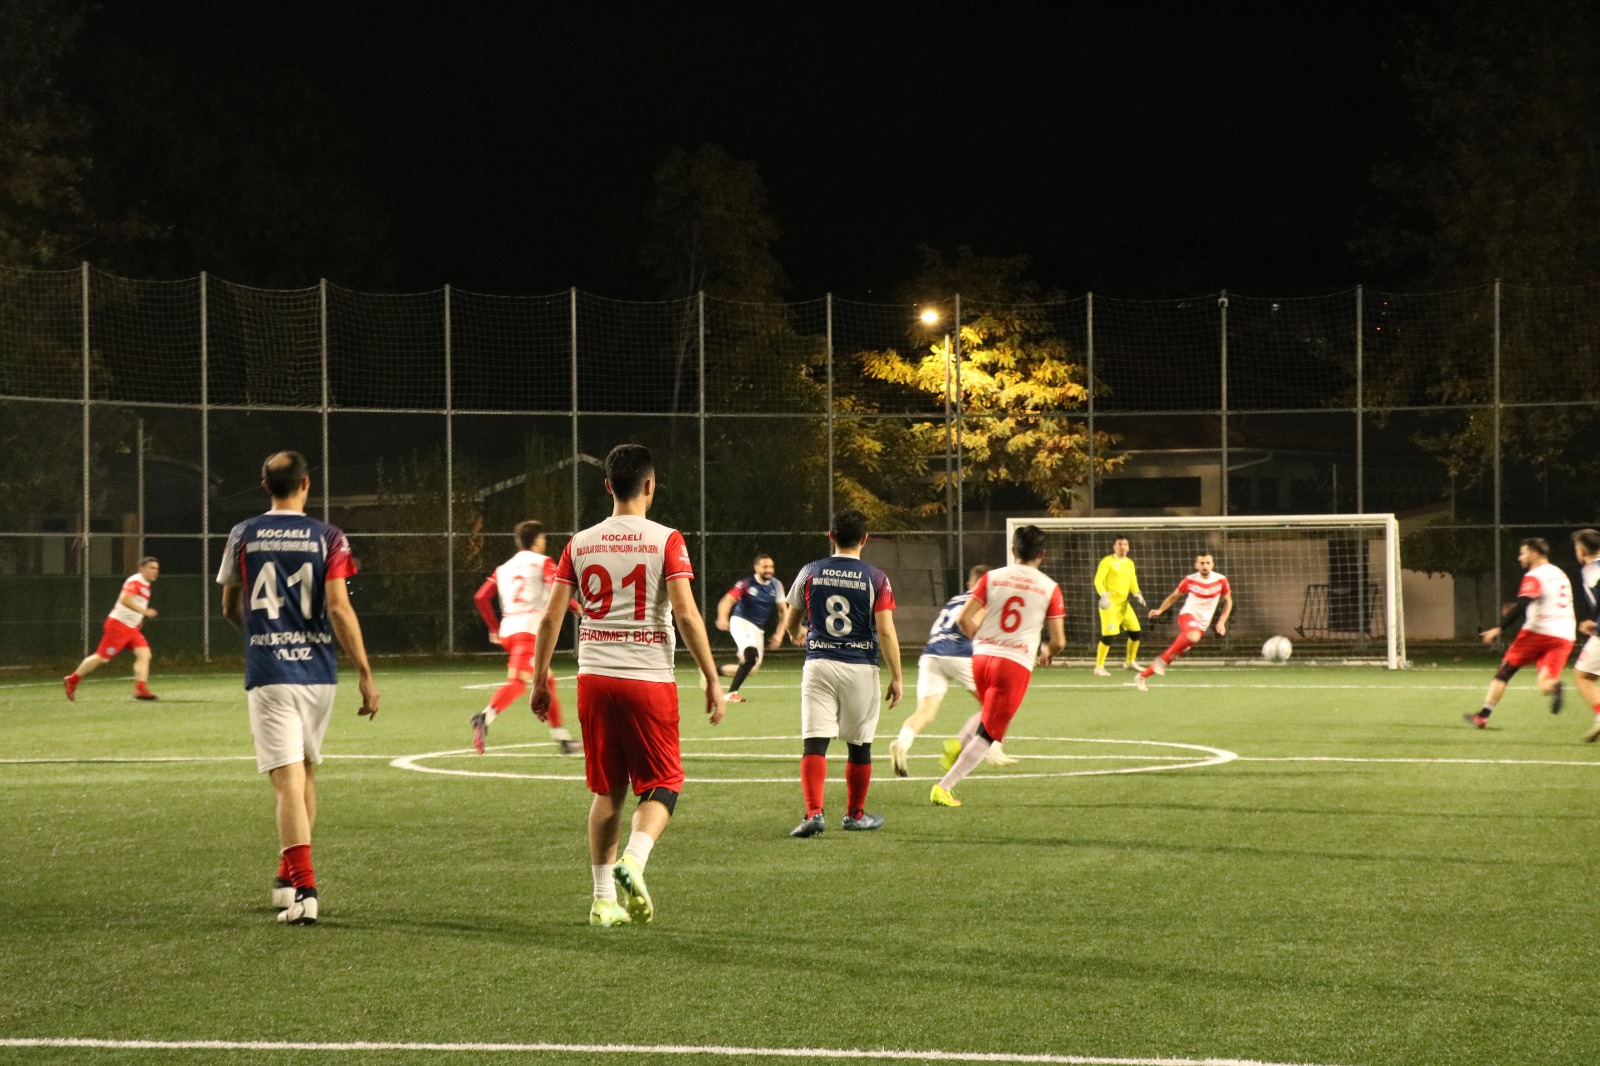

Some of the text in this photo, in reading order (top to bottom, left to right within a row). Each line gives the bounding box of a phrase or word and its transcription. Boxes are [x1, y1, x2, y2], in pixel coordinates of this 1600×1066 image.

[602, 533, 642, 541] KOCAELİ
[249, 561, 313, 620] 41
[581, 563, 647, 620] 91
[822, 568, 863, 579] KOCAELİ
[825, 594, 853, 638] 8
[1000, 595, 1026, 634] 6
[633, 628, 668, 645] BİÇER
